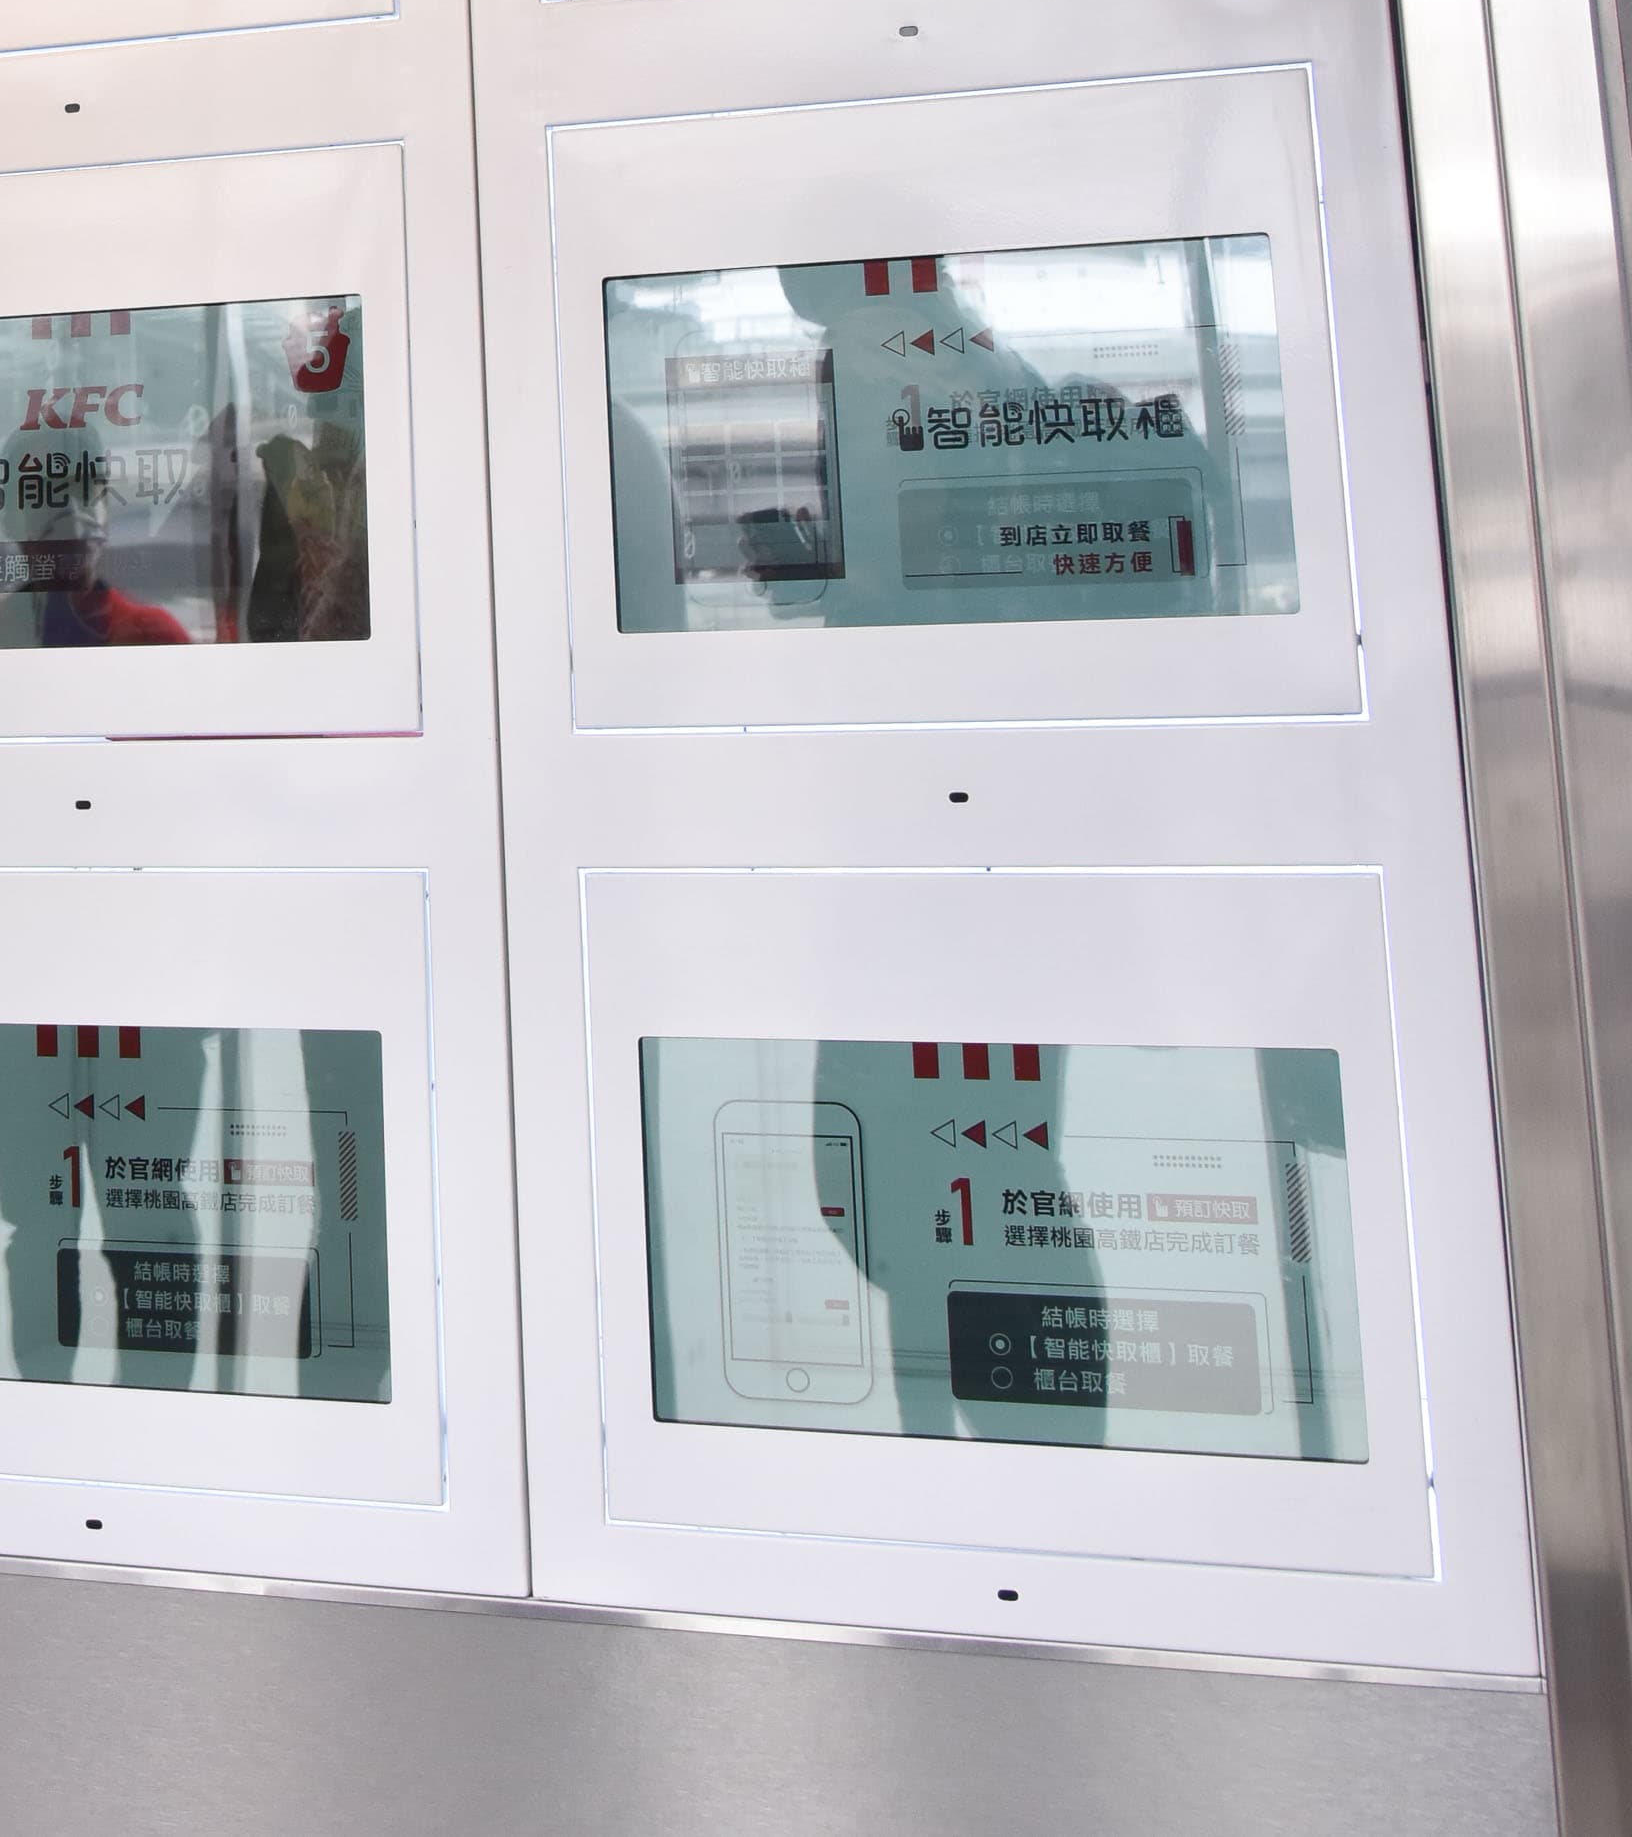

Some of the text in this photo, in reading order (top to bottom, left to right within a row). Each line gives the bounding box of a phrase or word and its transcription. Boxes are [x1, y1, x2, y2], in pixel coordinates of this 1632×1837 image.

[305, 330, 331, 374] 5
[19, 383, 144, 431] KFC
[999, 519, 1151, 547] 到店立即取餐
[1052, 550, 1154, 577] 快速方便
[105, 1156, 218, 1183] 於官網使用
[1002, 1189, 1250, 1221] 於官網使用 預訂快取
